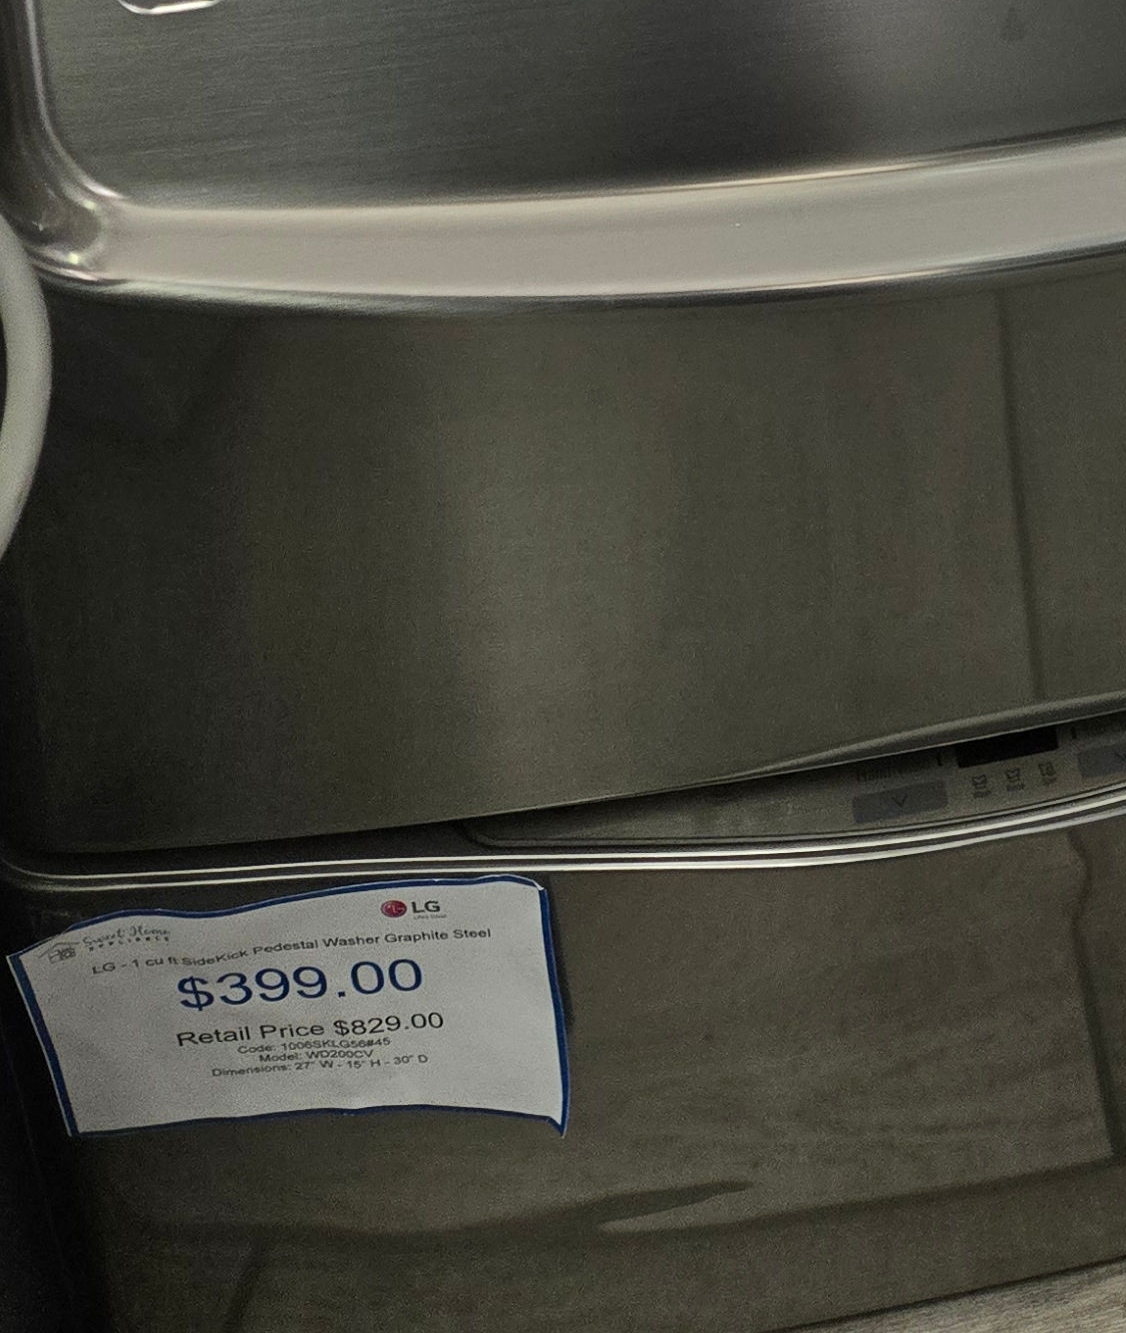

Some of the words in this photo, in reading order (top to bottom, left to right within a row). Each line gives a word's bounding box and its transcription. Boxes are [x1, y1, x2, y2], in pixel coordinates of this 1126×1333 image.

[411, 900, 441, 914] LG
[92, 962, 116, 975] LG
[145, 957, 164, 967] cu
[168, 956, 180, 965] ft
[181, 949, 248, 966] SideKick
[253, 938, 319, 955] Pedestal
[323, 935, 380, 948] Washer
[384, 930, 449, 944] Graphite
[453, 927, 491, 940] Steel
[177, 958, 423, 1012] $399.00
[176, 1026, 251, 1047] Retail
[259, 1023, 325, 1039] Price
[333, 1012, 444, 1037] $829.00
[237, 1044, 277, 1055] Code:
[259, 1052, 300, 1063] Model:
[306, 1049, 374, 1060] WD200CV
[212, 1063, 292, 1077] Dimensions:
[295, 1060, 315, 1071] 27"
[319, 1060, 334, 1069] W
[347, 1059, 366, 1070] 15"
[370, 1059, 381, 1068] H
[394, 1054, 414, 1065] 30"
[418, 1053, 429, 1064] D
